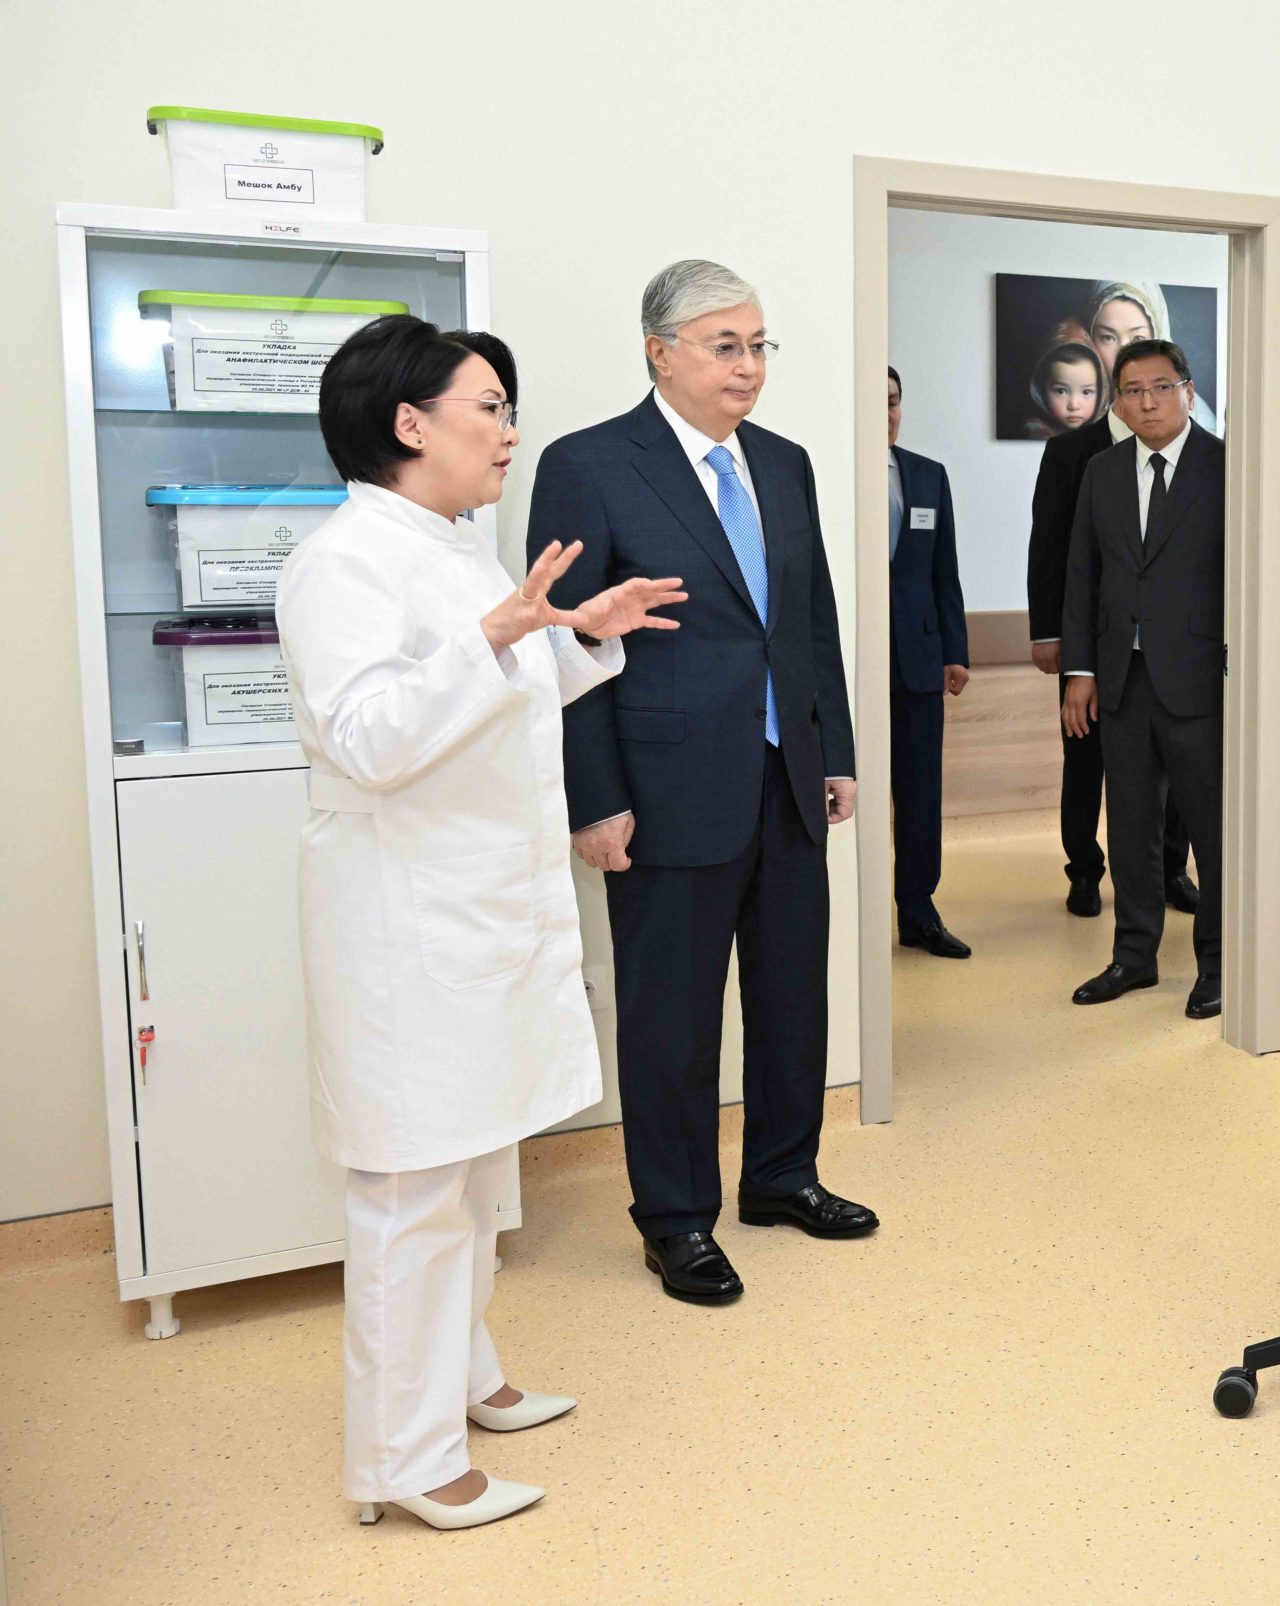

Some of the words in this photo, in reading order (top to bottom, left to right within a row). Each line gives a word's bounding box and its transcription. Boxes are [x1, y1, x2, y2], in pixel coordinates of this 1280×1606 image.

[237, 180, 273, 189] Мешок
[276, 182, 302, 192] Амбу
[265, 225, 300, 233] HILFE
[226, 357, 309, 365] АНАФИЛАКТИЧЕСКОМ
